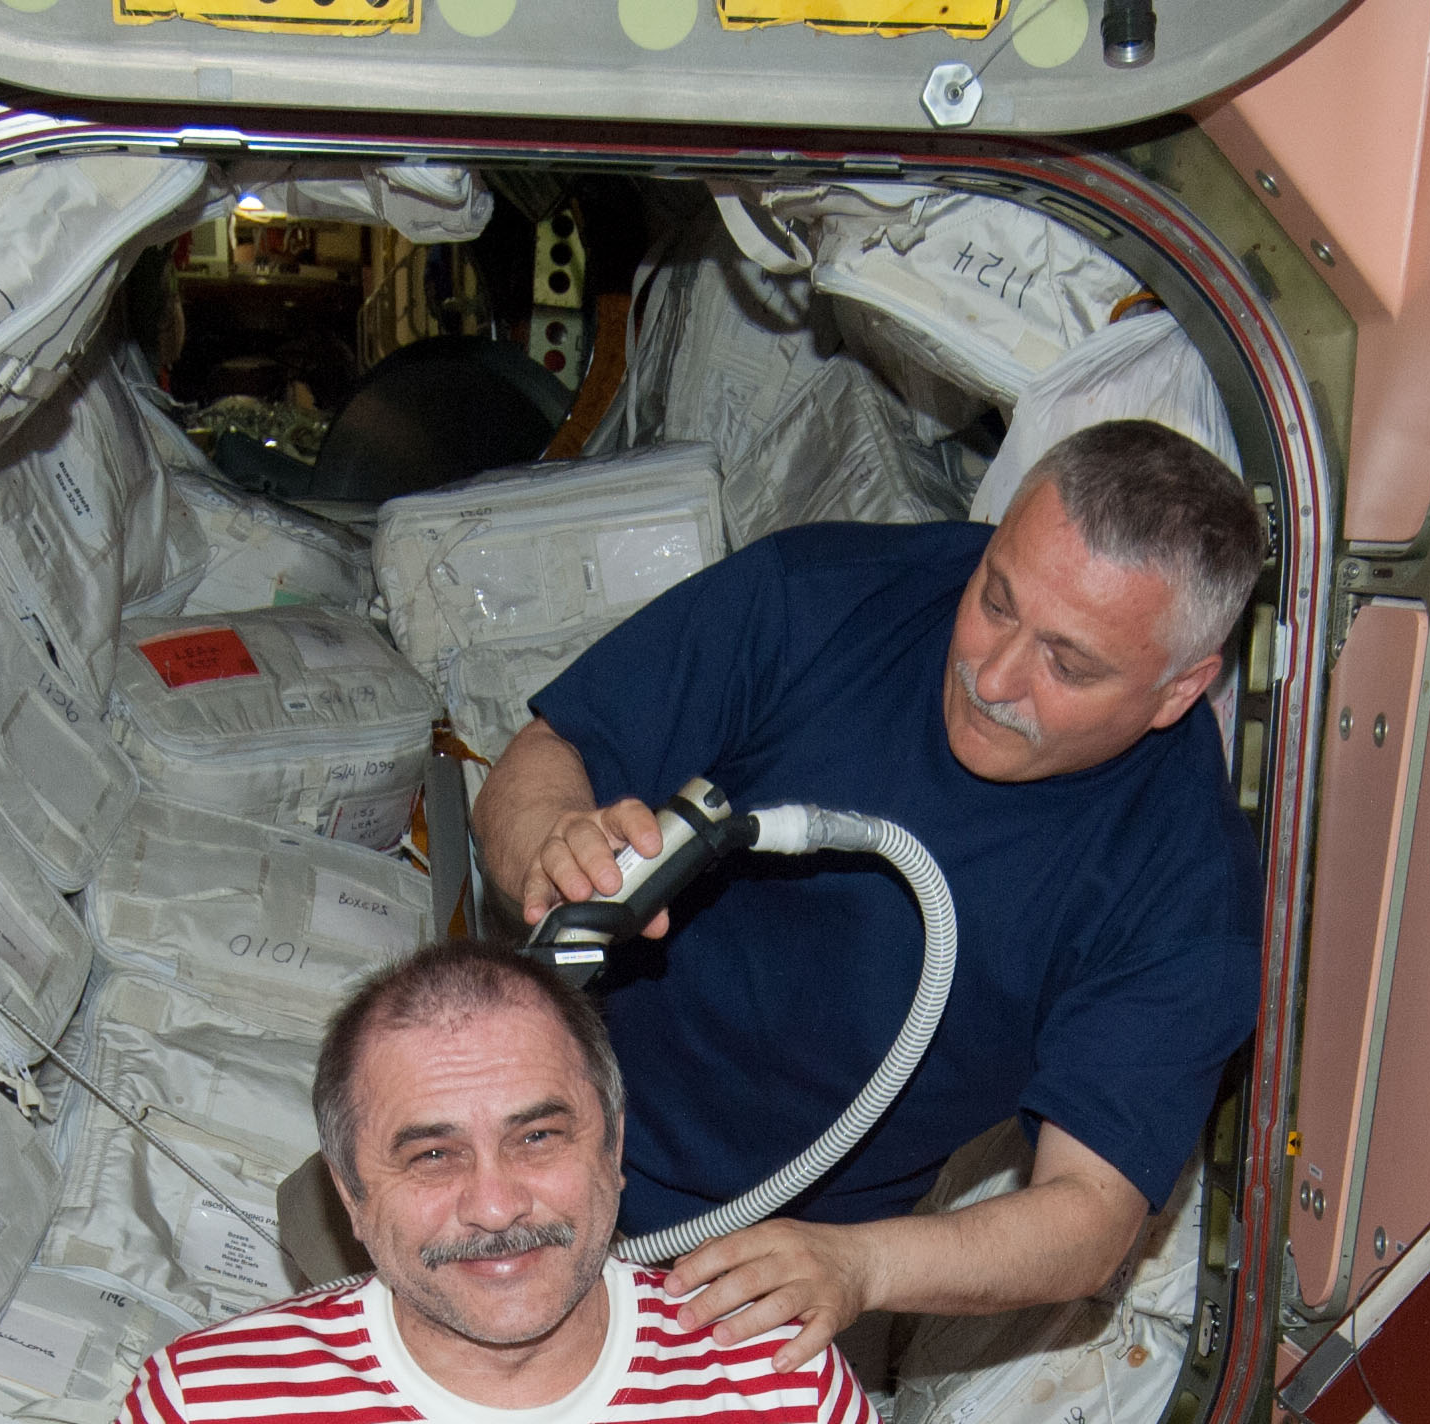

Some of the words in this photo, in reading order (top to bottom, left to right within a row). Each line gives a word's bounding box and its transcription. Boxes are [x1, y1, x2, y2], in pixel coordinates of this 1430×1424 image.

[363, 761, 396, 777] 1099
[337, 891, 389, 916] BOXERS
[201, 1199, 224, 1211] USOS
[99, 1290, 128, 1308] 1196
